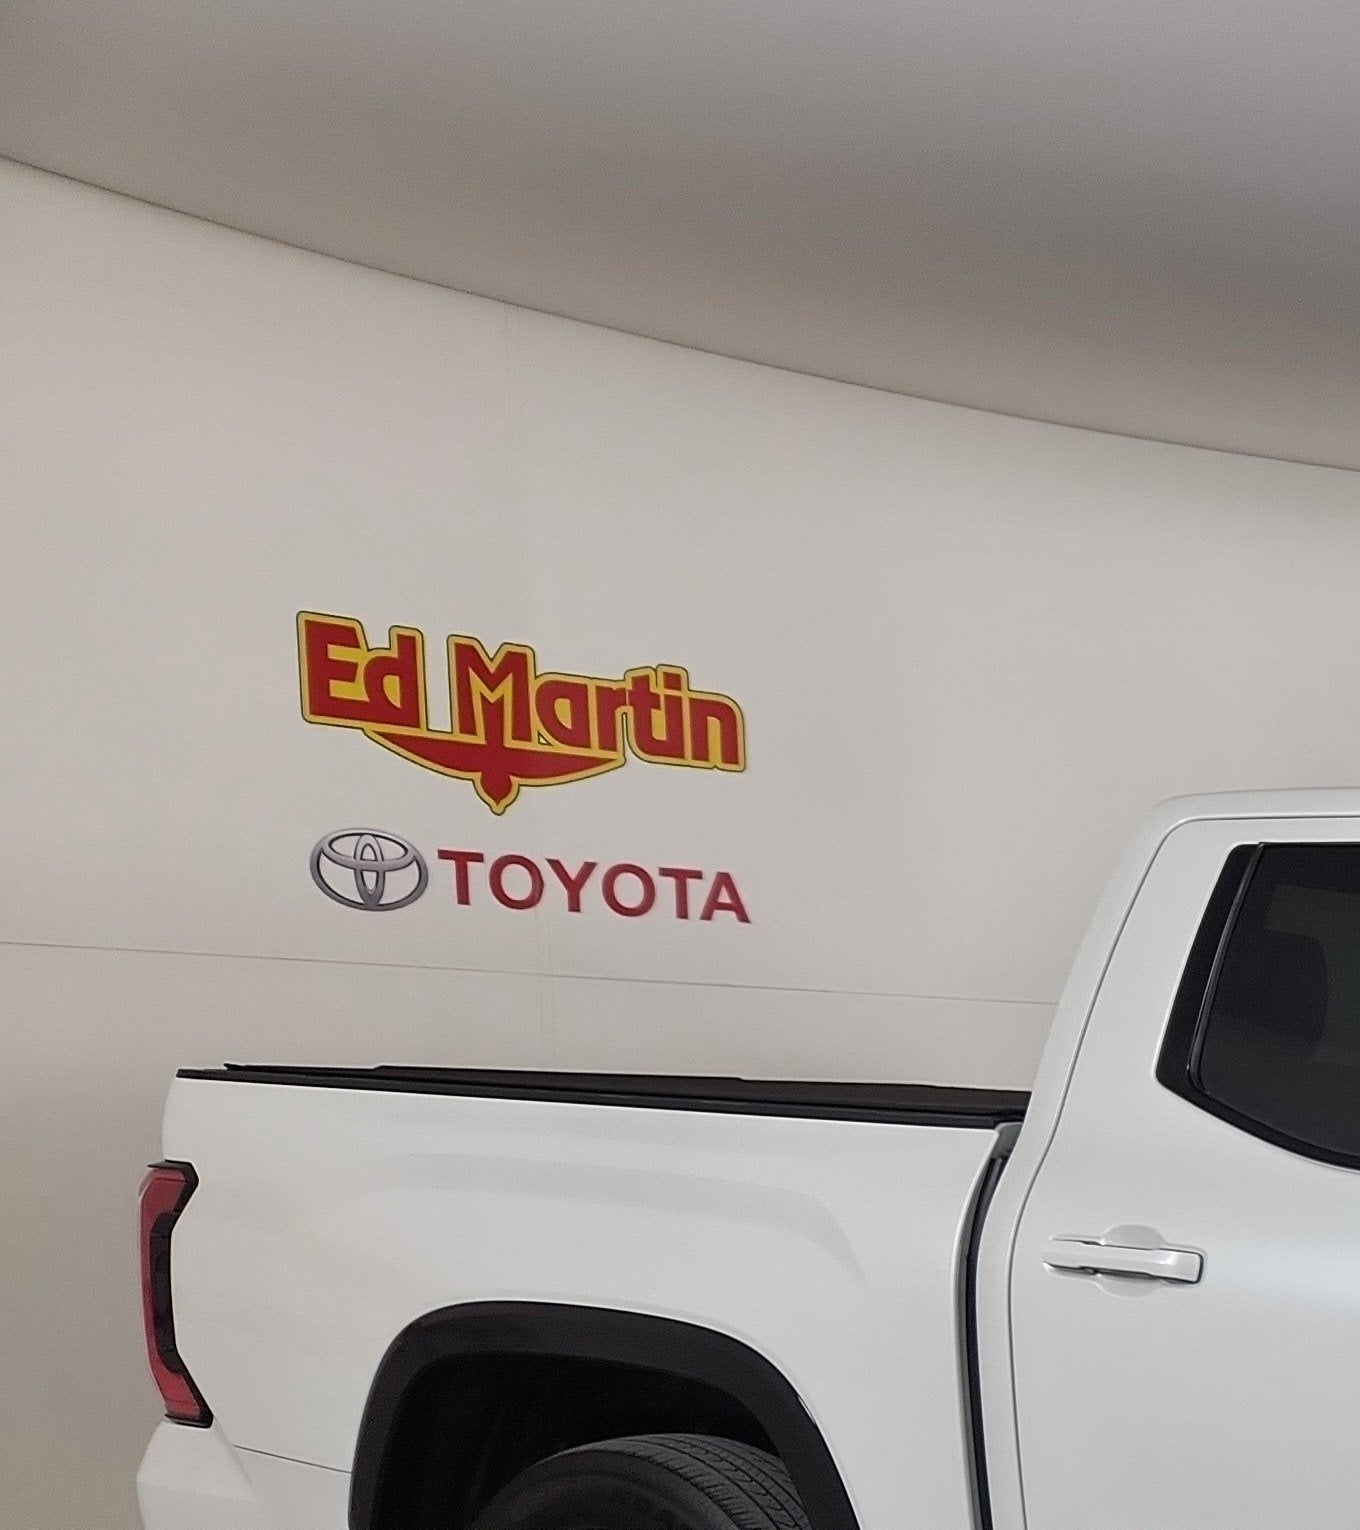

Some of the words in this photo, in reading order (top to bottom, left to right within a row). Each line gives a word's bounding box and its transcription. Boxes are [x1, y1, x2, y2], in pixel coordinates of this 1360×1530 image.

[303, 617, 422, 730] Ed
[451, 641, 741, 768] Martin
[436, 848, 752, 925] TOYOTA
